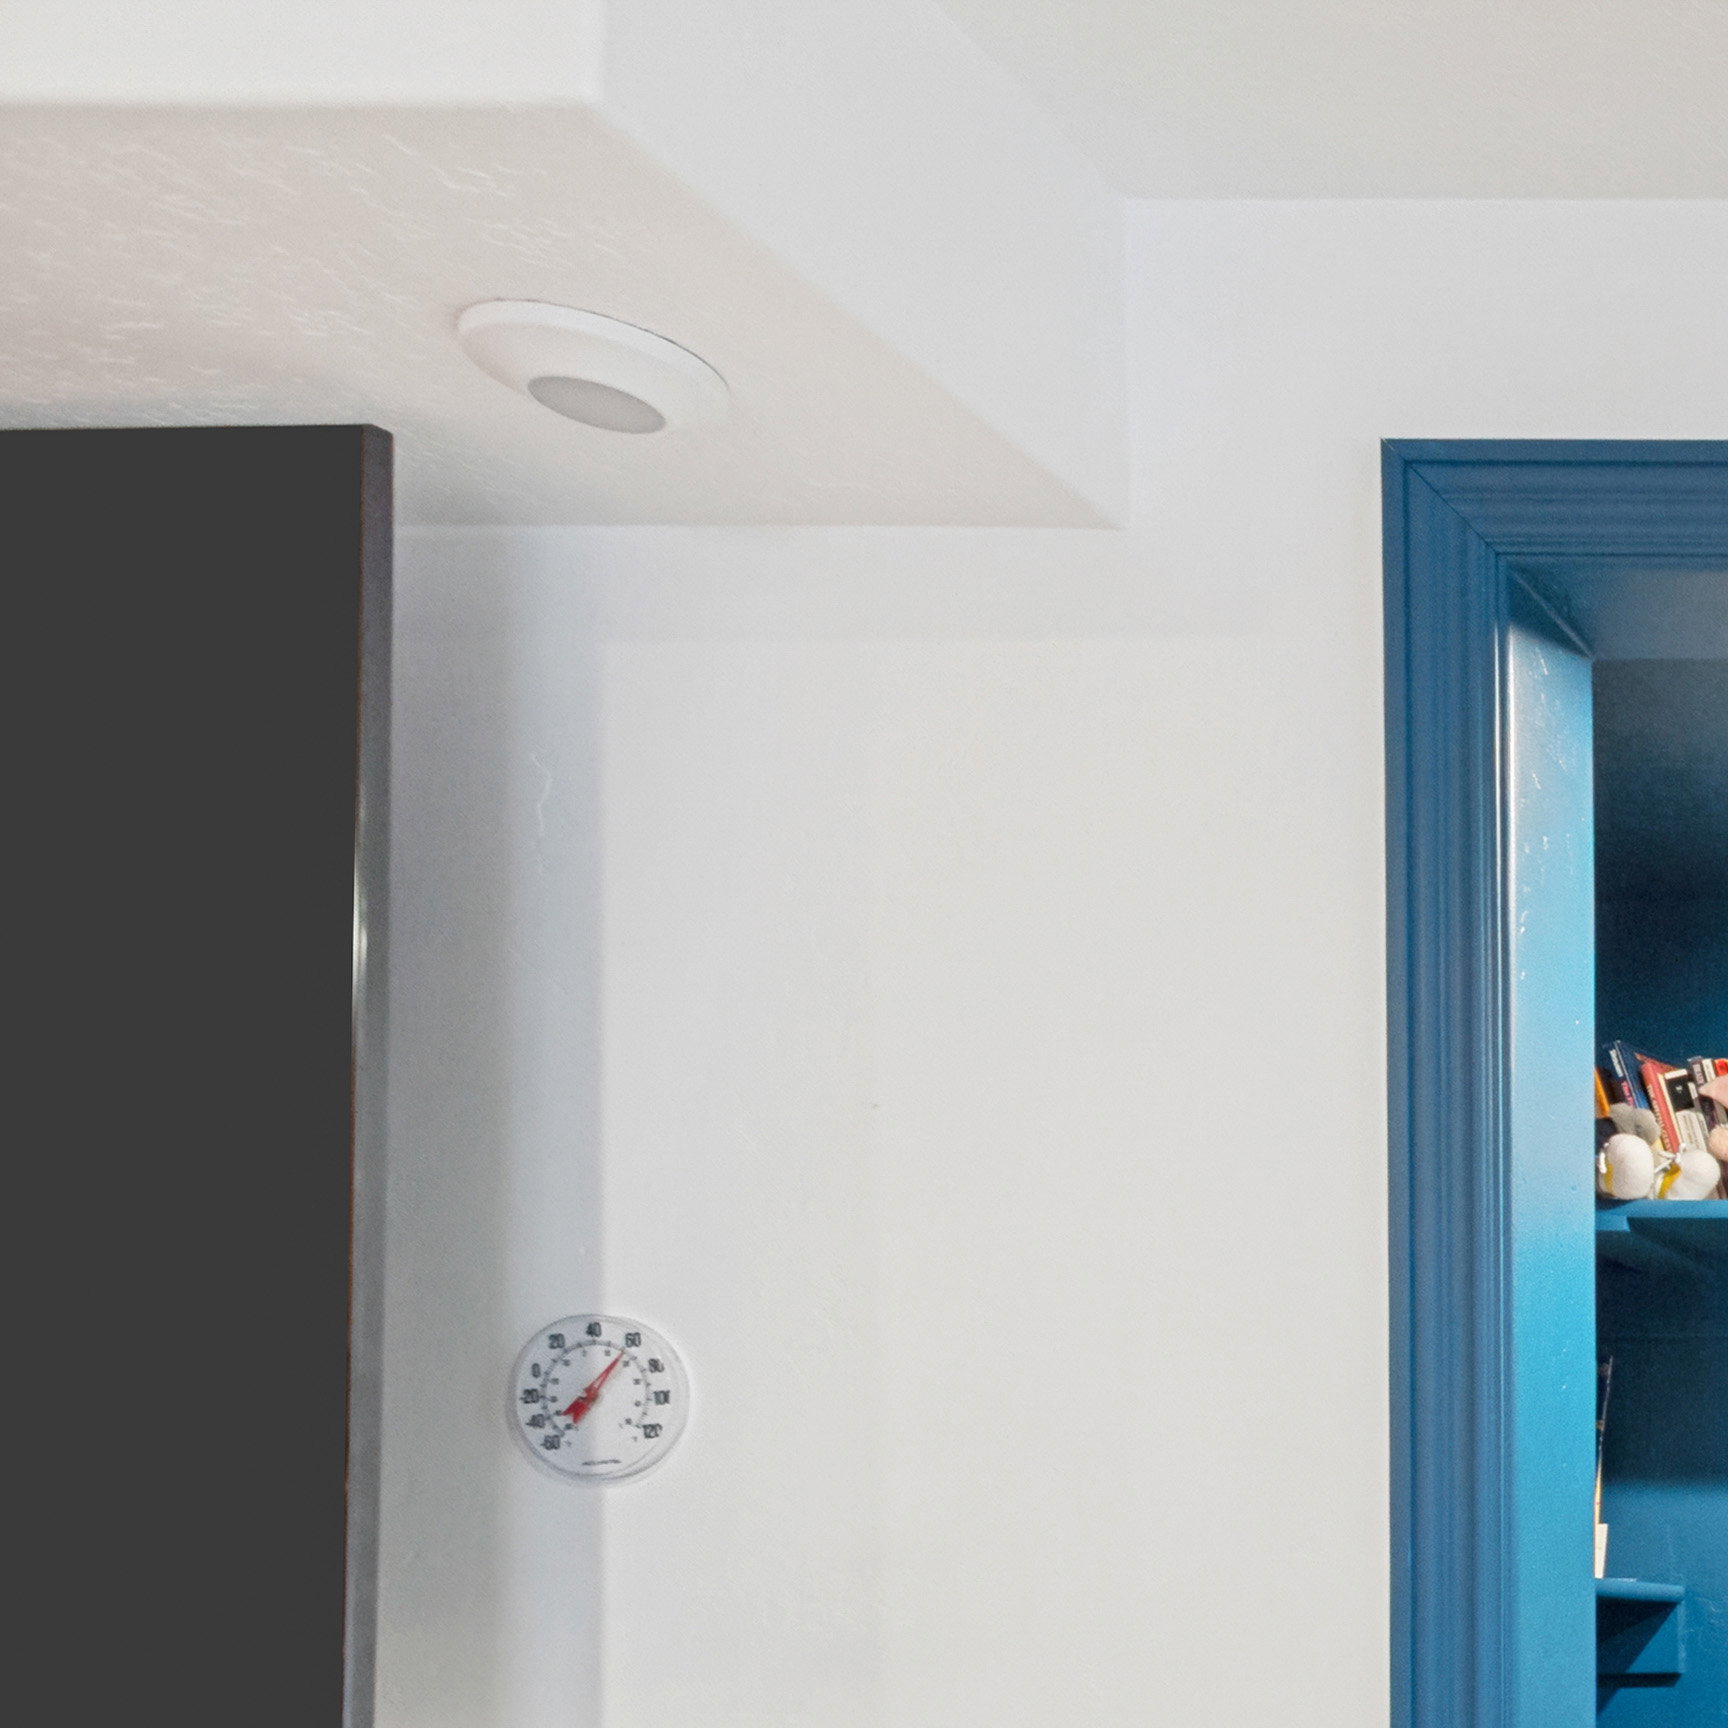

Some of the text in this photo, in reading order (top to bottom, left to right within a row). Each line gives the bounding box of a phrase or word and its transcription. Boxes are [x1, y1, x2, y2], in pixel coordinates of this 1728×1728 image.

[586, 1322, 602, 1338] 40
[549, 1333, 565, 1349] 20
[625, 1332, 642, 1347] 60
[531, 1363, 541, 1378] 0
